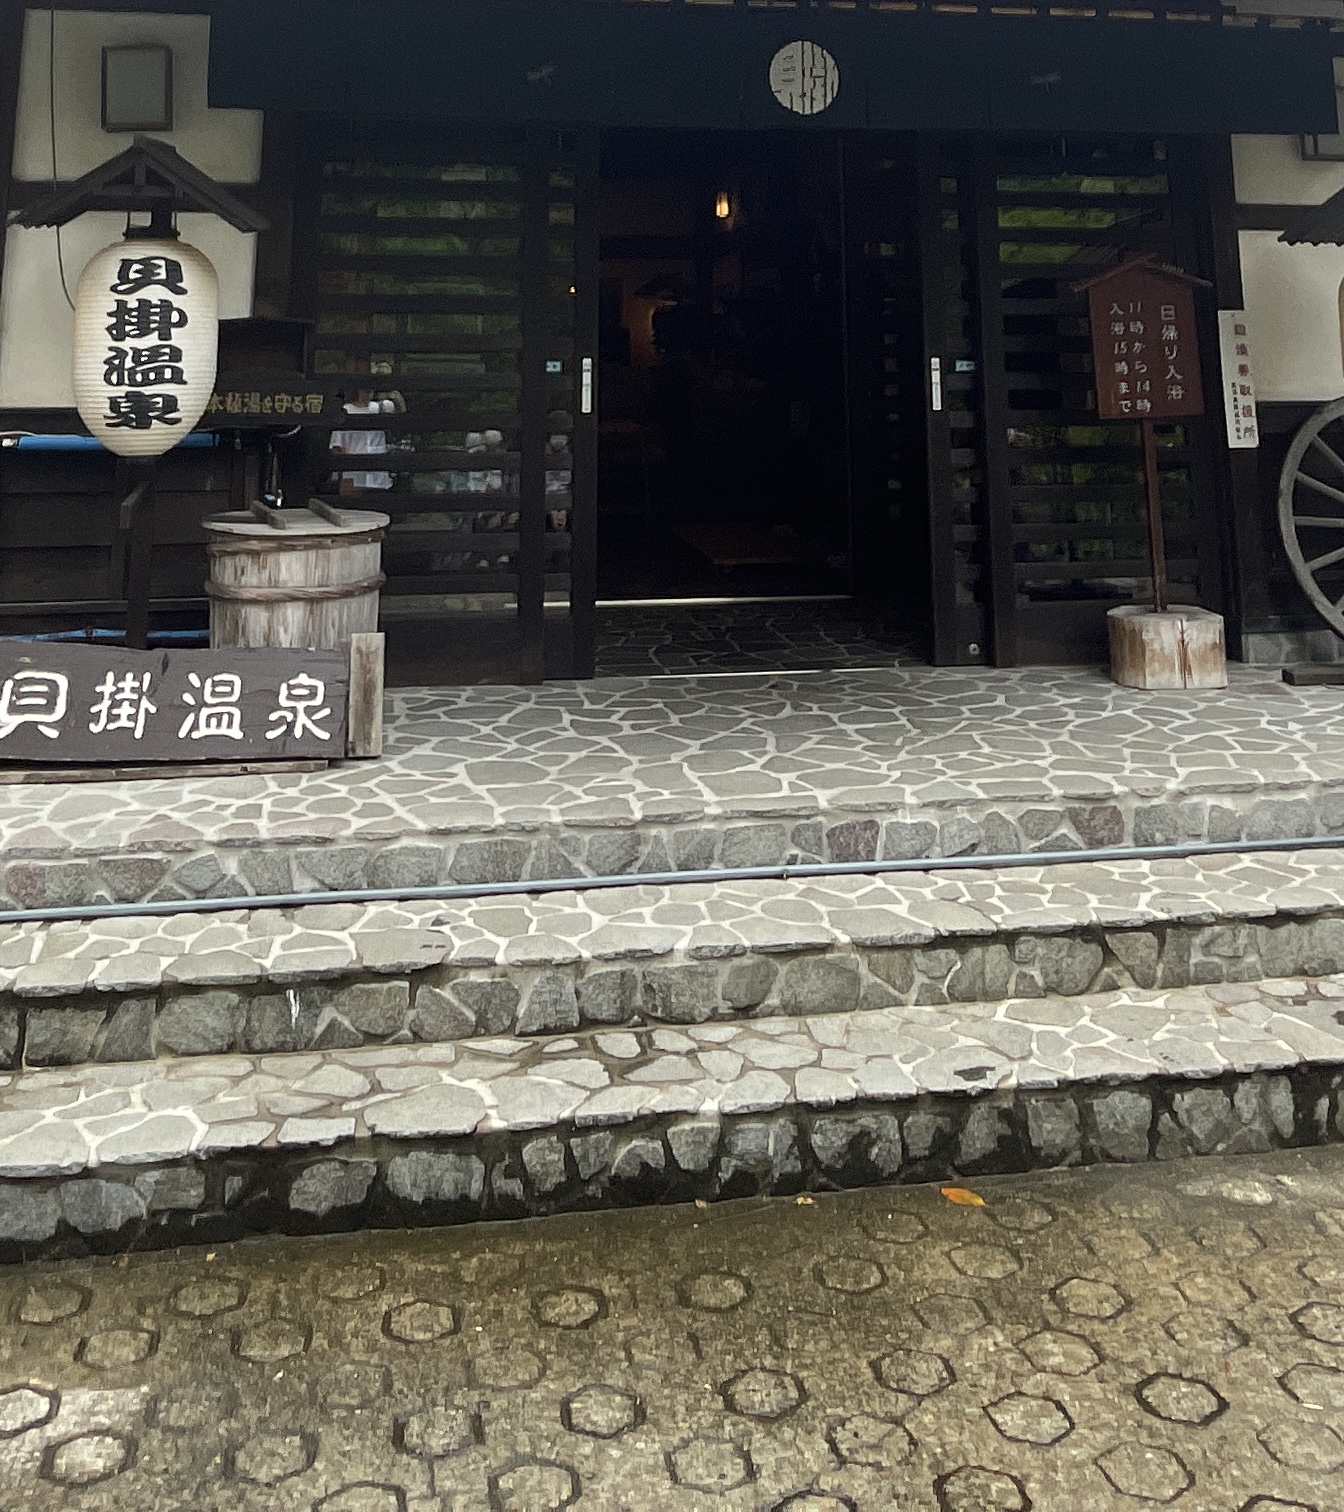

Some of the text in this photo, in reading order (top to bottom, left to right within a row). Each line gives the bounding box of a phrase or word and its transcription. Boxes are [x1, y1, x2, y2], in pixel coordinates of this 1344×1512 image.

[103, 256, 188, 429] 貝掛温泉
[1160, 304, 1185, 400] 日帰り入浴
